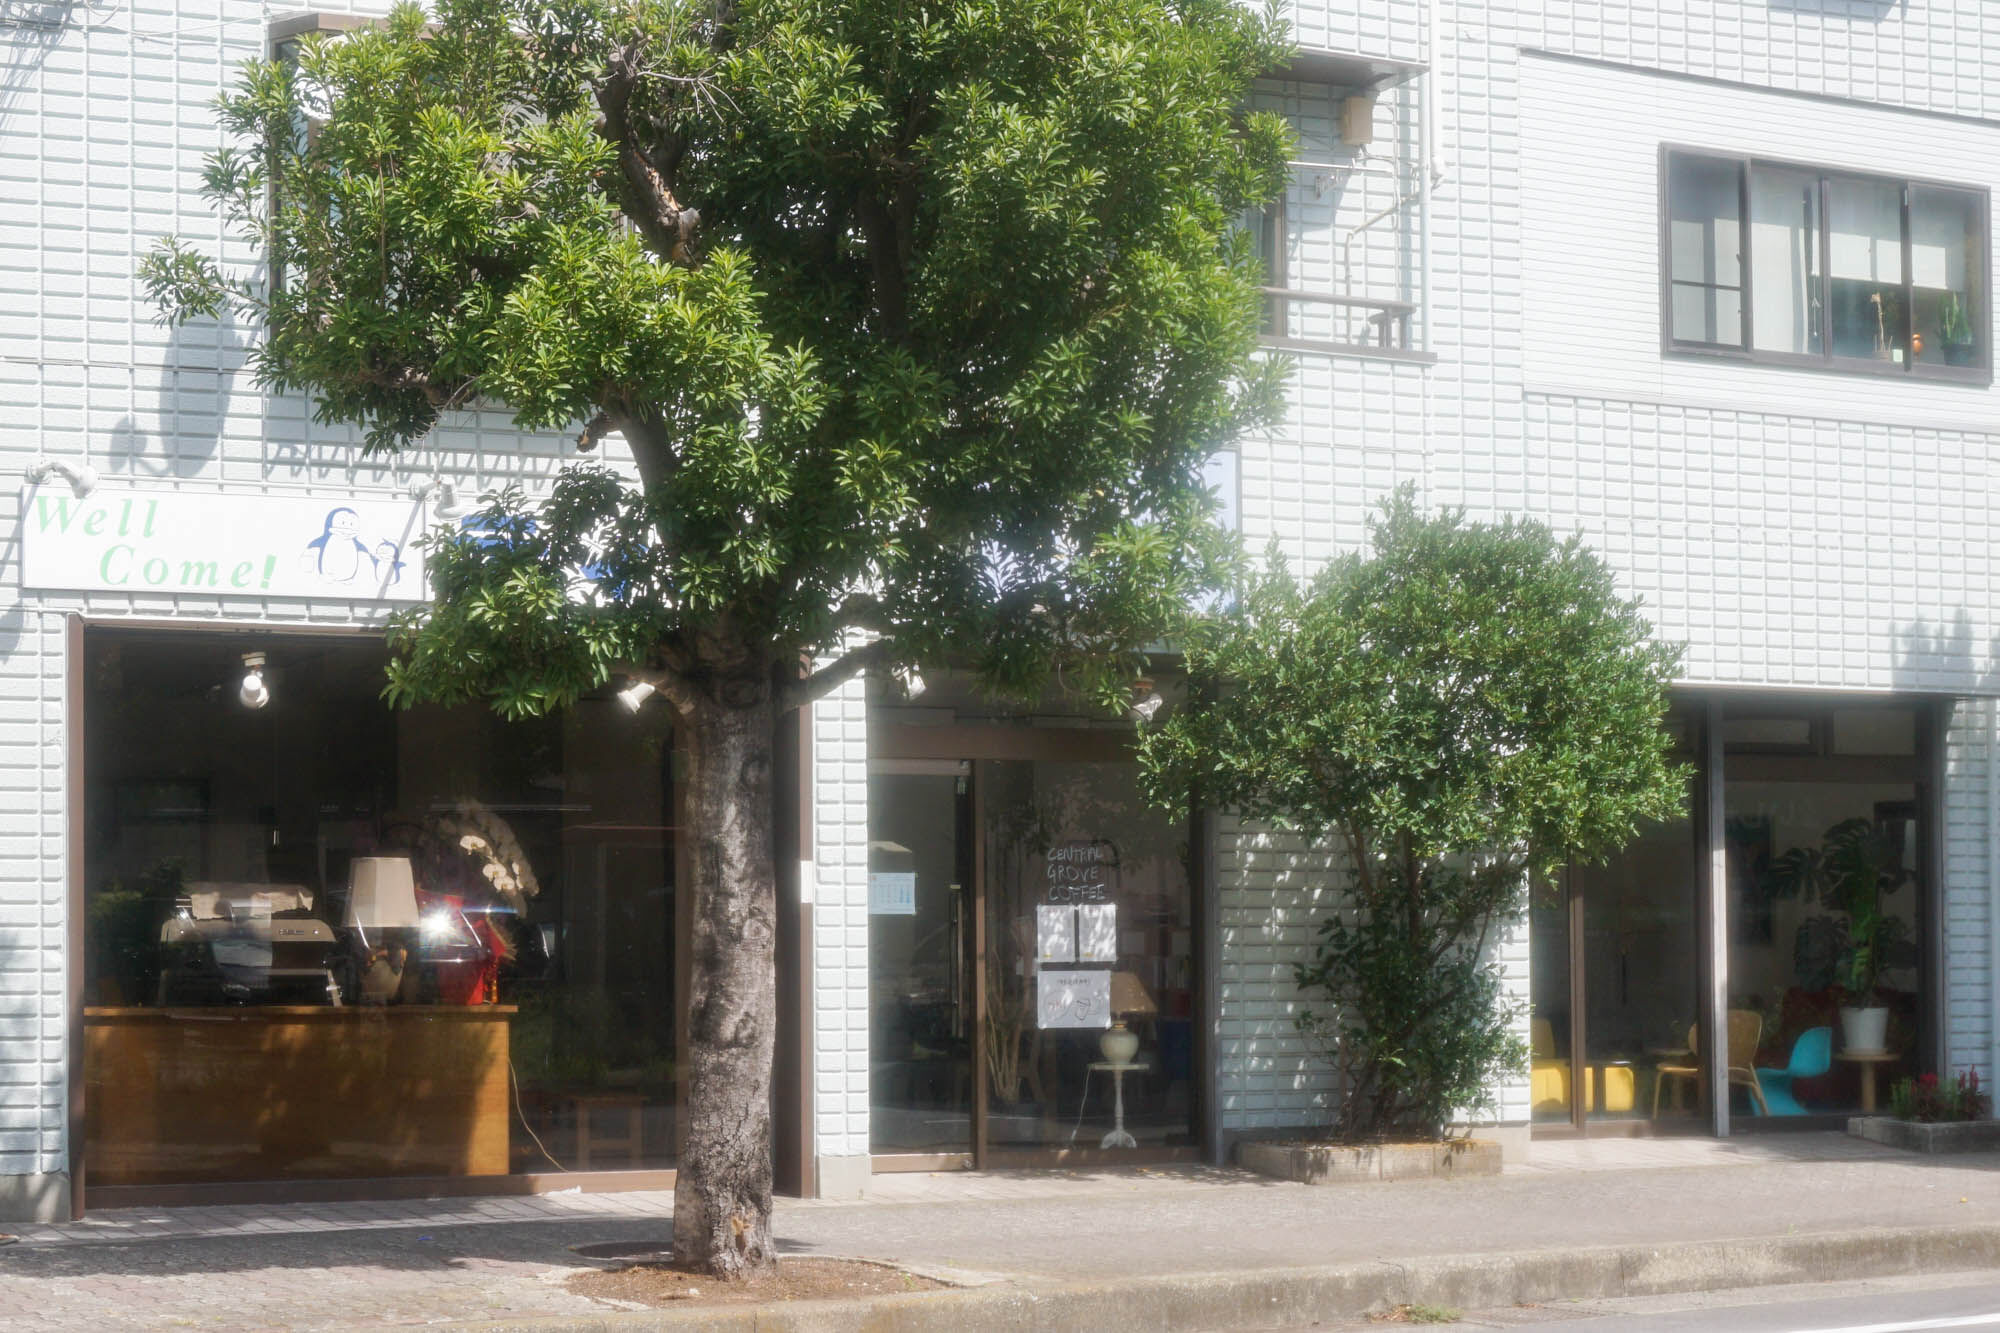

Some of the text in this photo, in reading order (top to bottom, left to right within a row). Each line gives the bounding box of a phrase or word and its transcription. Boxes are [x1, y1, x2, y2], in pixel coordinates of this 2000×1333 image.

[36, 495, 159, 538] Well
[99, 544, 277, 589] Come!
[1047, 863, 1098, 883] GROVE
[1048, 884, 1105, 901] COFFEE
